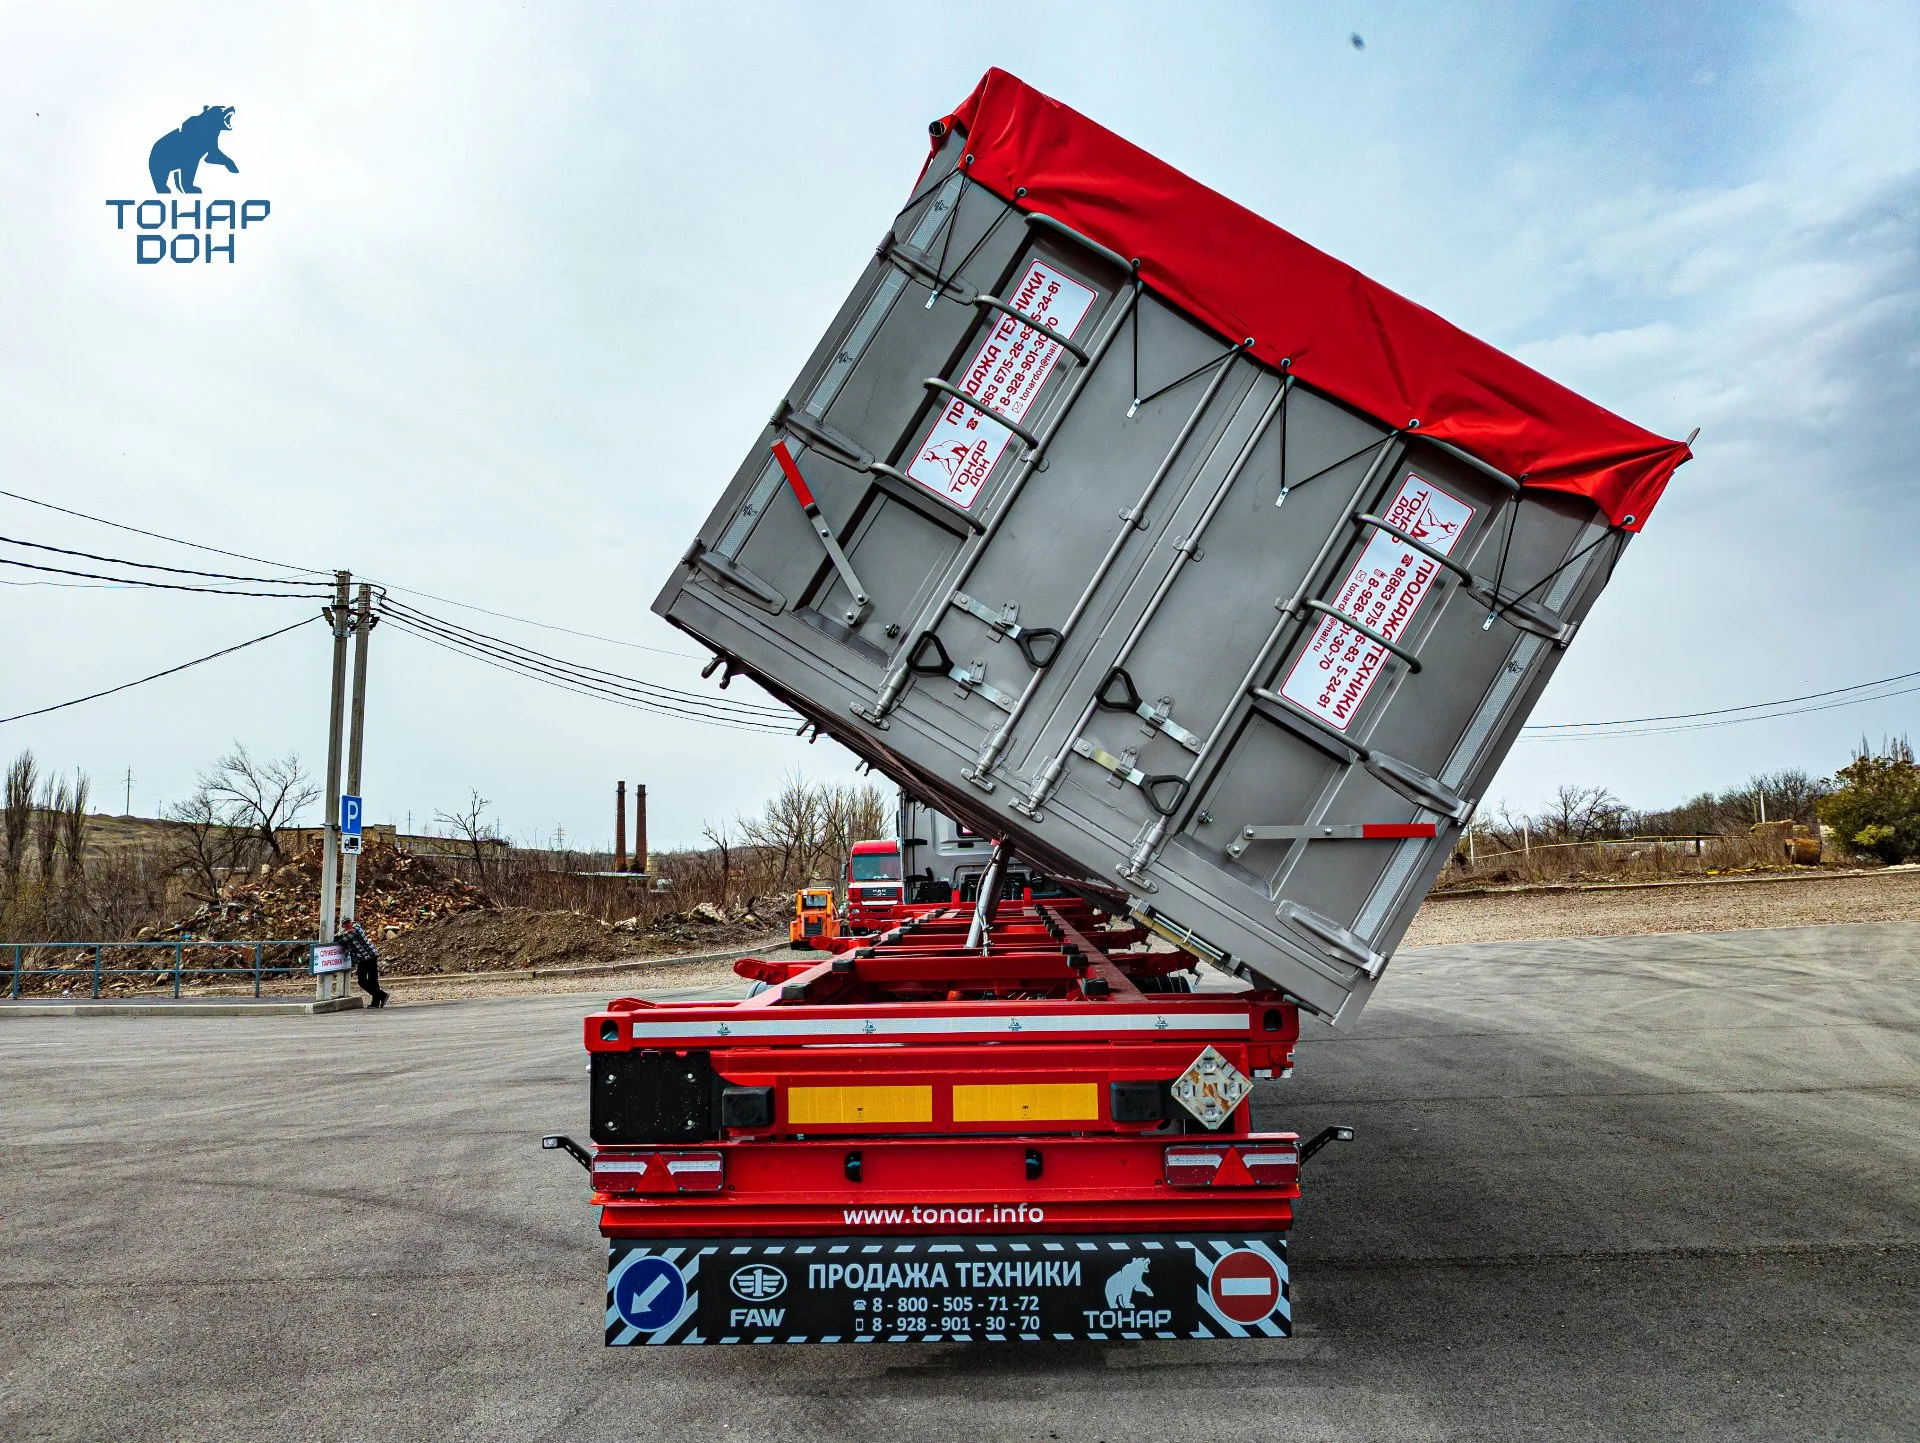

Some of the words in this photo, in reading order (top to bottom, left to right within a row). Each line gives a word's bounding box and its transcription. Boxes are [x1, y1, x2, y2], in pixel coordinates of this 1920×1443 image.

[973, 383, 998, 417] 8863
[993, 324, 1034, 385] 67)5-26-83
[999, 315, 1059, 406] 8-928-901-3070
[1019, 338, 1060, 401] tonardon@mail.
[950, 439, 989, 496] ТОНАР
[969, 458, 989, 486] ДОН
[1388, 495, 1410, 525] ДОН
[1378, 559, 1434, 641] ПРОДАЖА
[1379, 566, 1406, 601] 8(863
[1312, 581, 1359, 653] tonard@mail.ru
[1340, 599, 1386, 665] 67)5-6-83,
[1316, 664, 1348, 708] 5-24-81
[1332, 641, 1385, 719] ТЕХНИКИ
[347, 801, 359, 830] P
[843, 1204, 1045, 1225] www.tonar.info
[808, 1262, 950, 1292] ПРОДАЖА
[955, 1260, 1082, 1287] ТЕХНИКИ
[730, 1309, 786, 1327] FAW
[1083, 1310, 1172, 1328] ТОНАР
